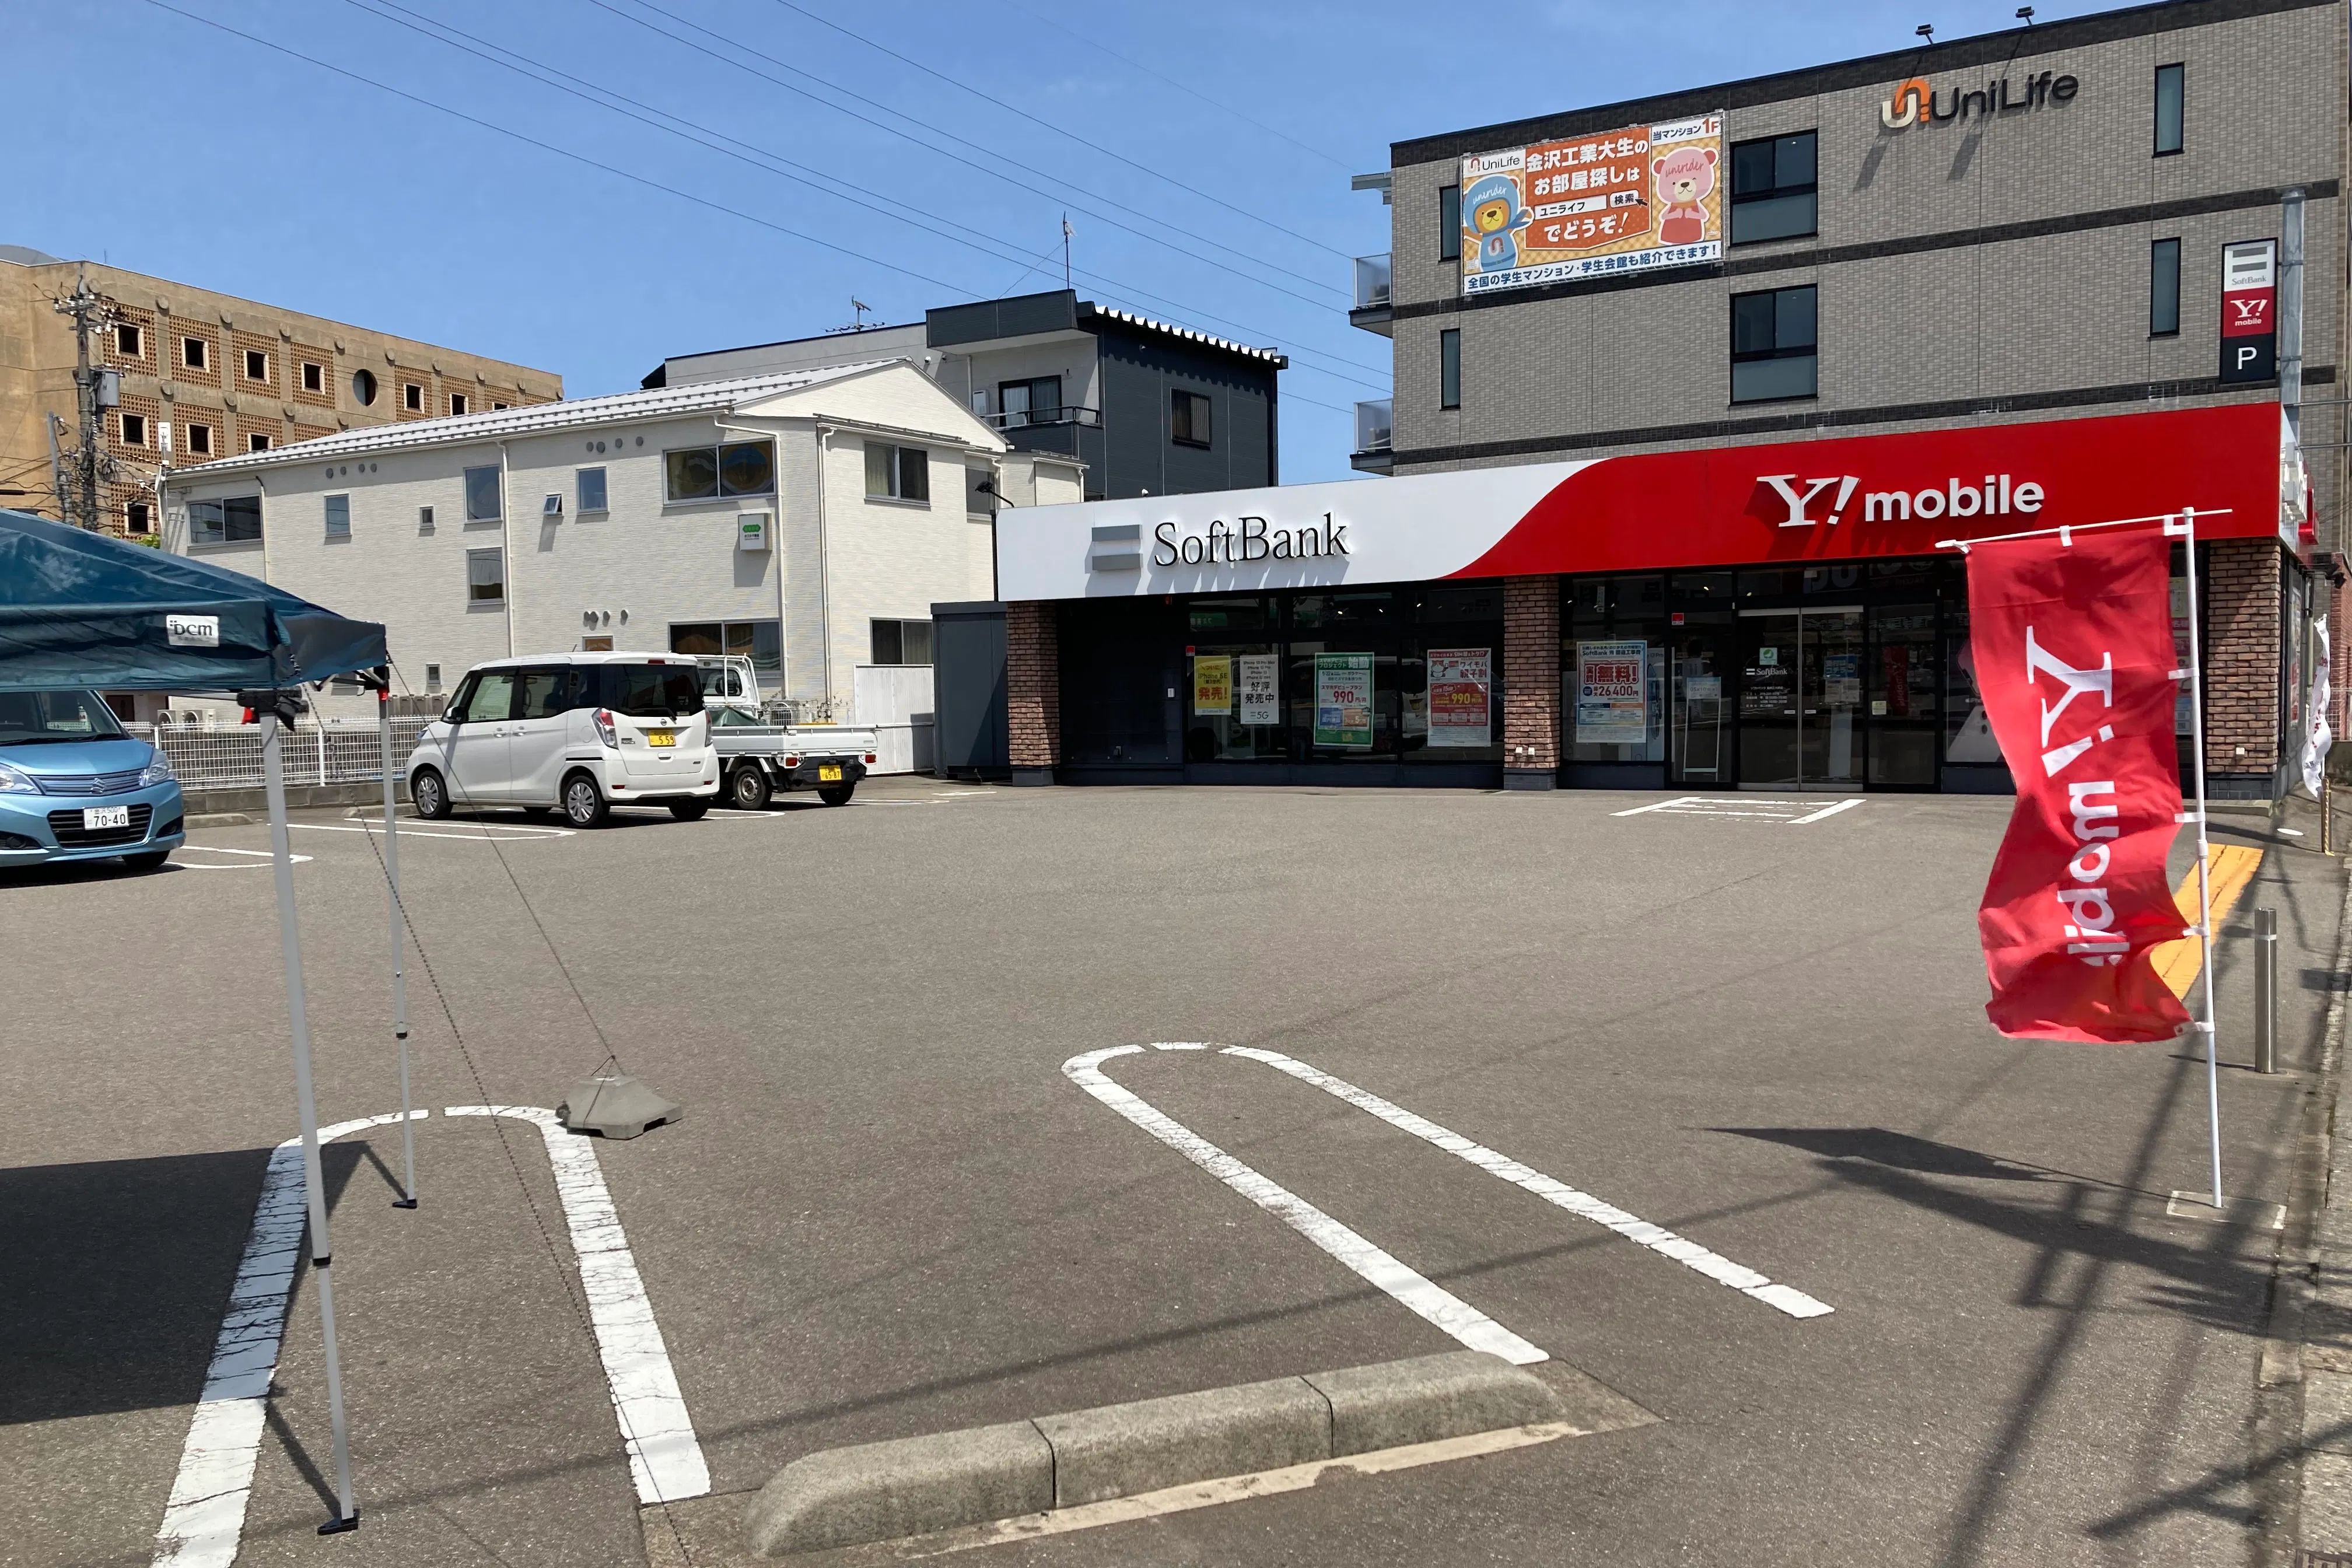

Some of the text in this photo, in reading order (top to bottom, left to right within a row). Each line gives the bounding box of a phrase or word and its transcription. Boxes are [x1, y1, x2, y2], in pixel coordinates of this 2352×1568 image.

[1931, 71, 2079, 120] UniLife
[1482, 156, 1520, 170] UniLife
[1526, 138, 1648, 173] 金沢工業大生の
[1534, 167, 1640, 196] お部屋探しは
[1540, 193, 1634, 217] ユニライフ 検索
[1544, 212, 1629, 243] でどうぞ!
[2232, 275, 2267, 285] SoftBank
[2230, 299, 2268, 318] Y!
[2235, 317, 2262, 326] mobile
[2238, 346, 2258, 370] P
[1154, 512, 1352, 566] SoftBank
[1245, 693, 1275, 704] 発売中
[93, 814, 126, 827] 70-40
